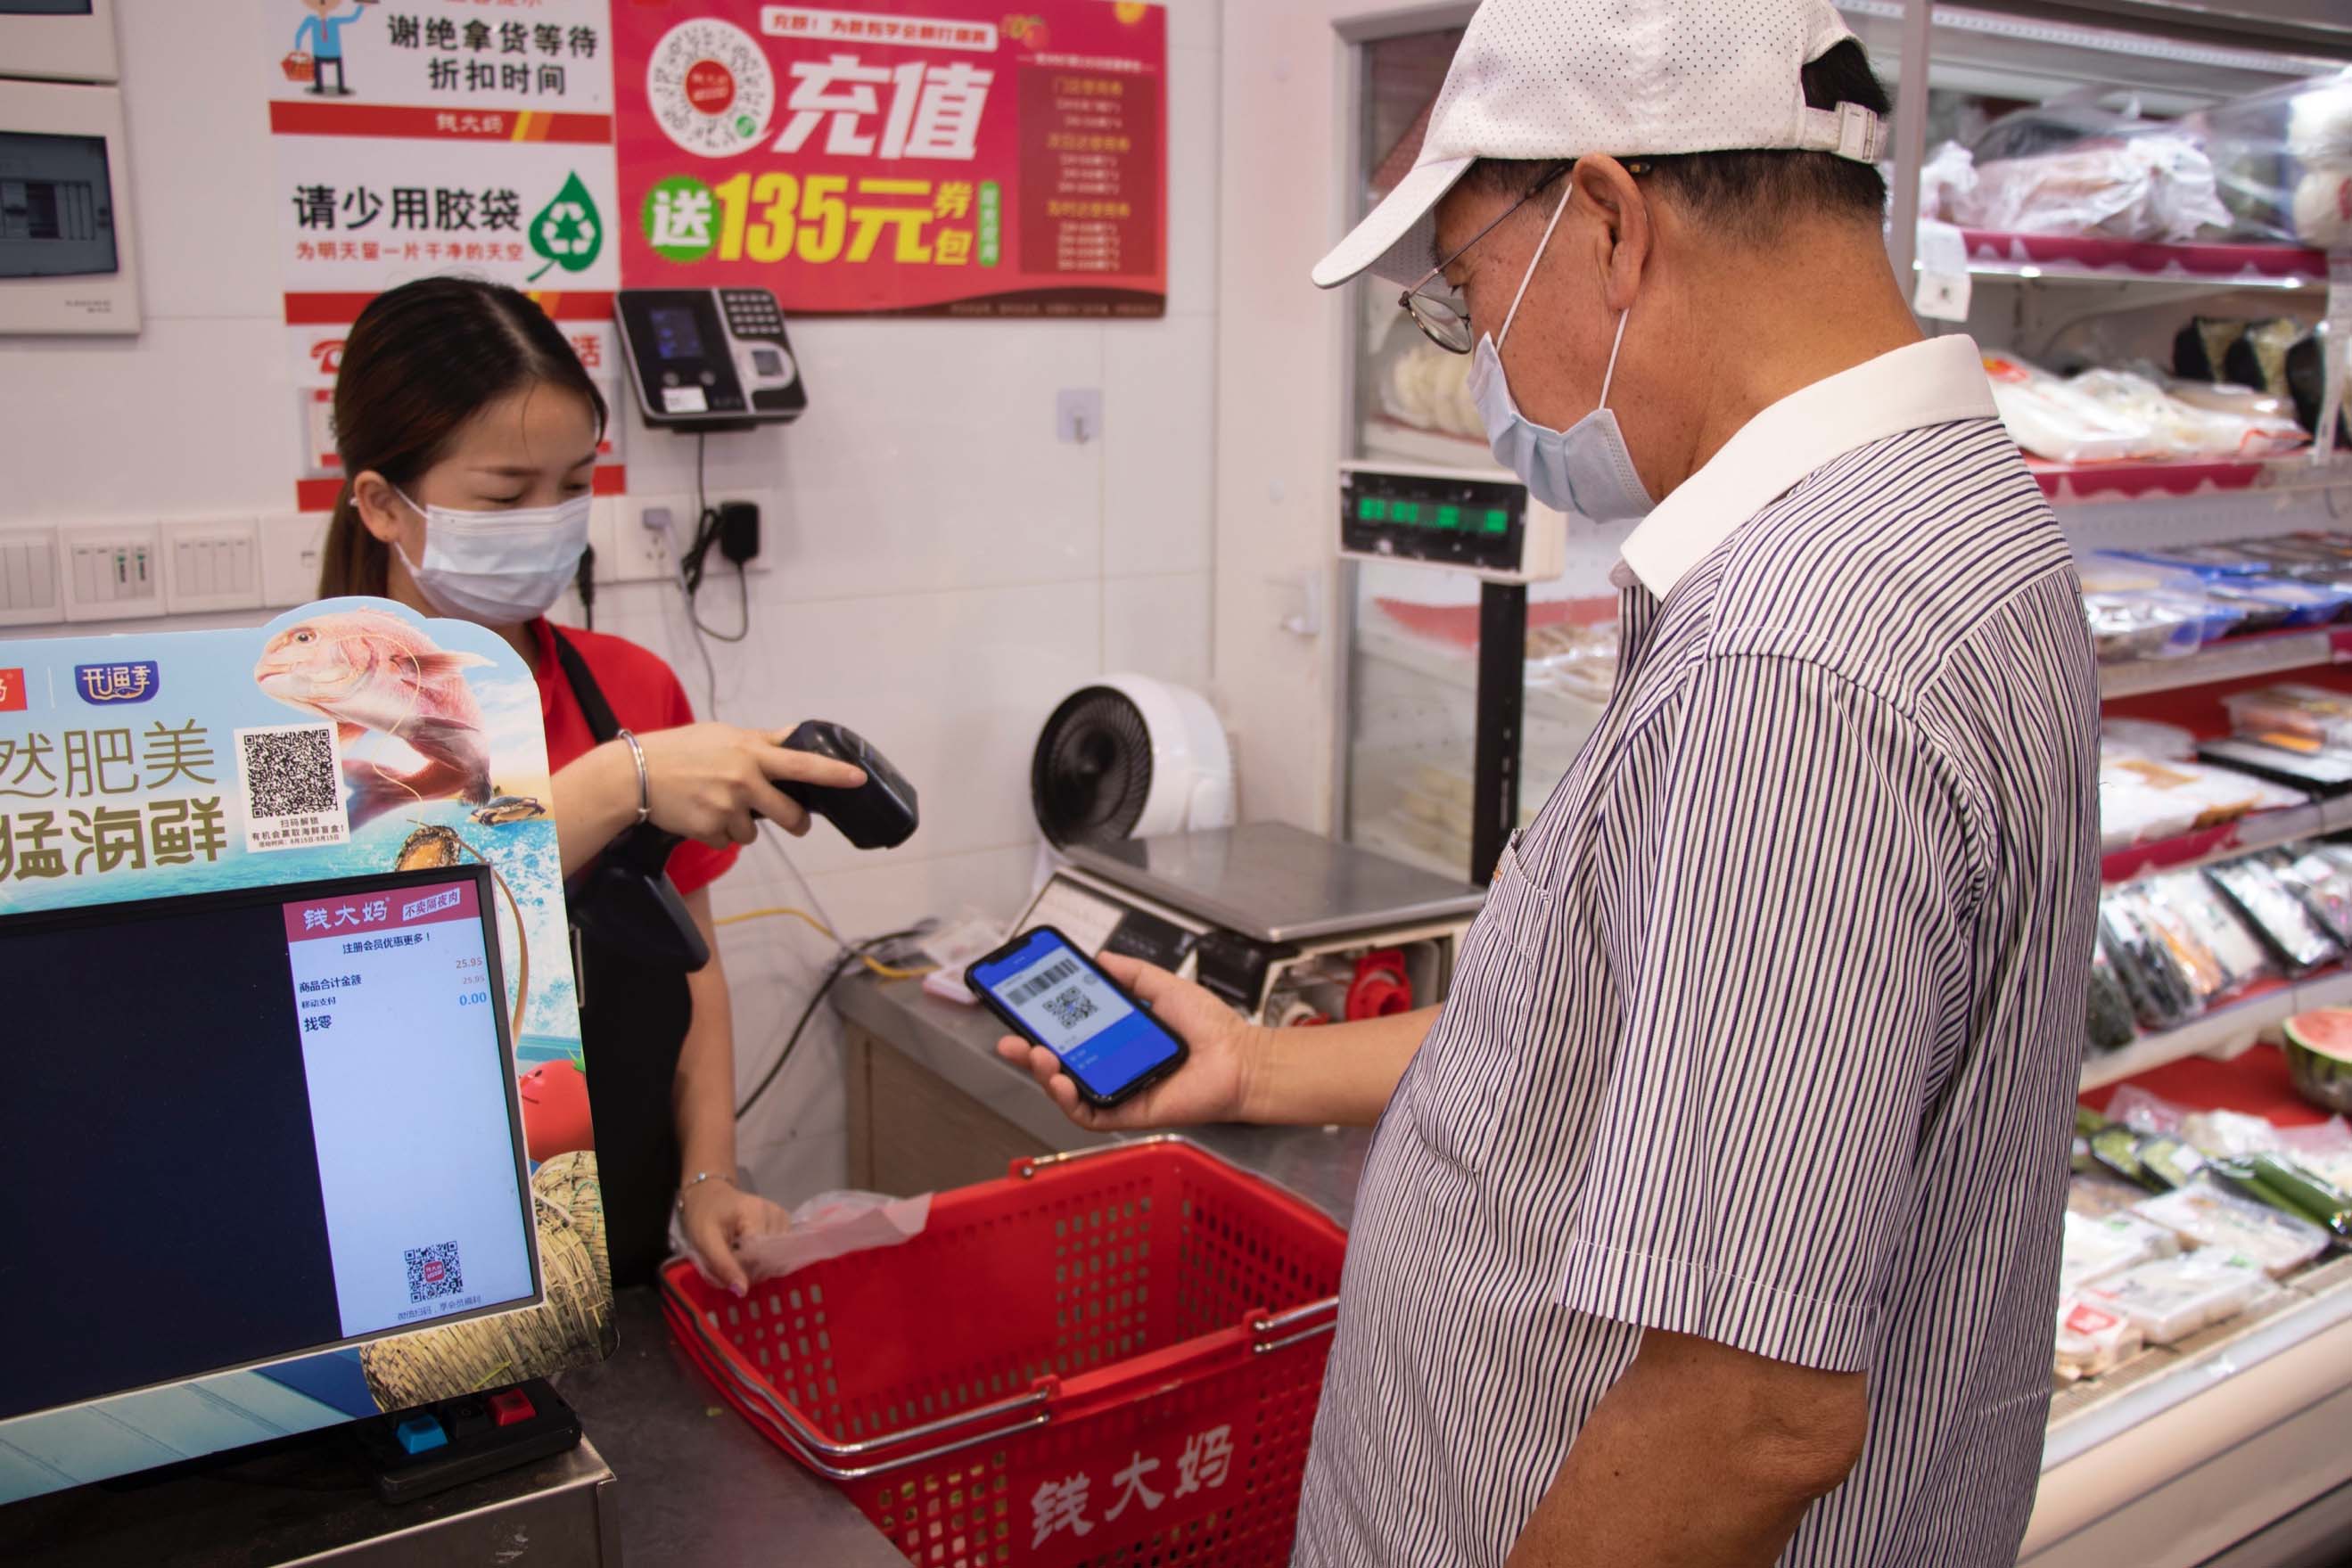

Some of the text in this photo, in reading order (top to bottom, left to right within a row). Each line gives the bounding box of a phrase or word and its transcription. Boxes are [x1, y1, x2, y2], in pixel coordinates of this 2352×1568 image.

[388, 15, 597, 59] 谢绝拿货等待
[429, 58, 566, 95] 折扣时间
[771, 54, 994, 160] 充值
[292, 185, 522, 232] 请少用胶袋
[652, 188, 713, 249] 送
[716, 173, 934, 264] 135元
[297, 241, 524, 262] 为明天留一片干净的天空
[0, 718, 218, 800] 然肥美
[0, 796, 227, 883] 猛海鲜
[303, 891, 459, 931] 钱大妈 不卖隔夜肉
[299, 974, 362, 993] 商品合计金额
[459, 991, 487, 1006] 0.00
[304, 1014, 333, 1032] 找零
[1030, 1424, 1234, 1551] 钱大妈
